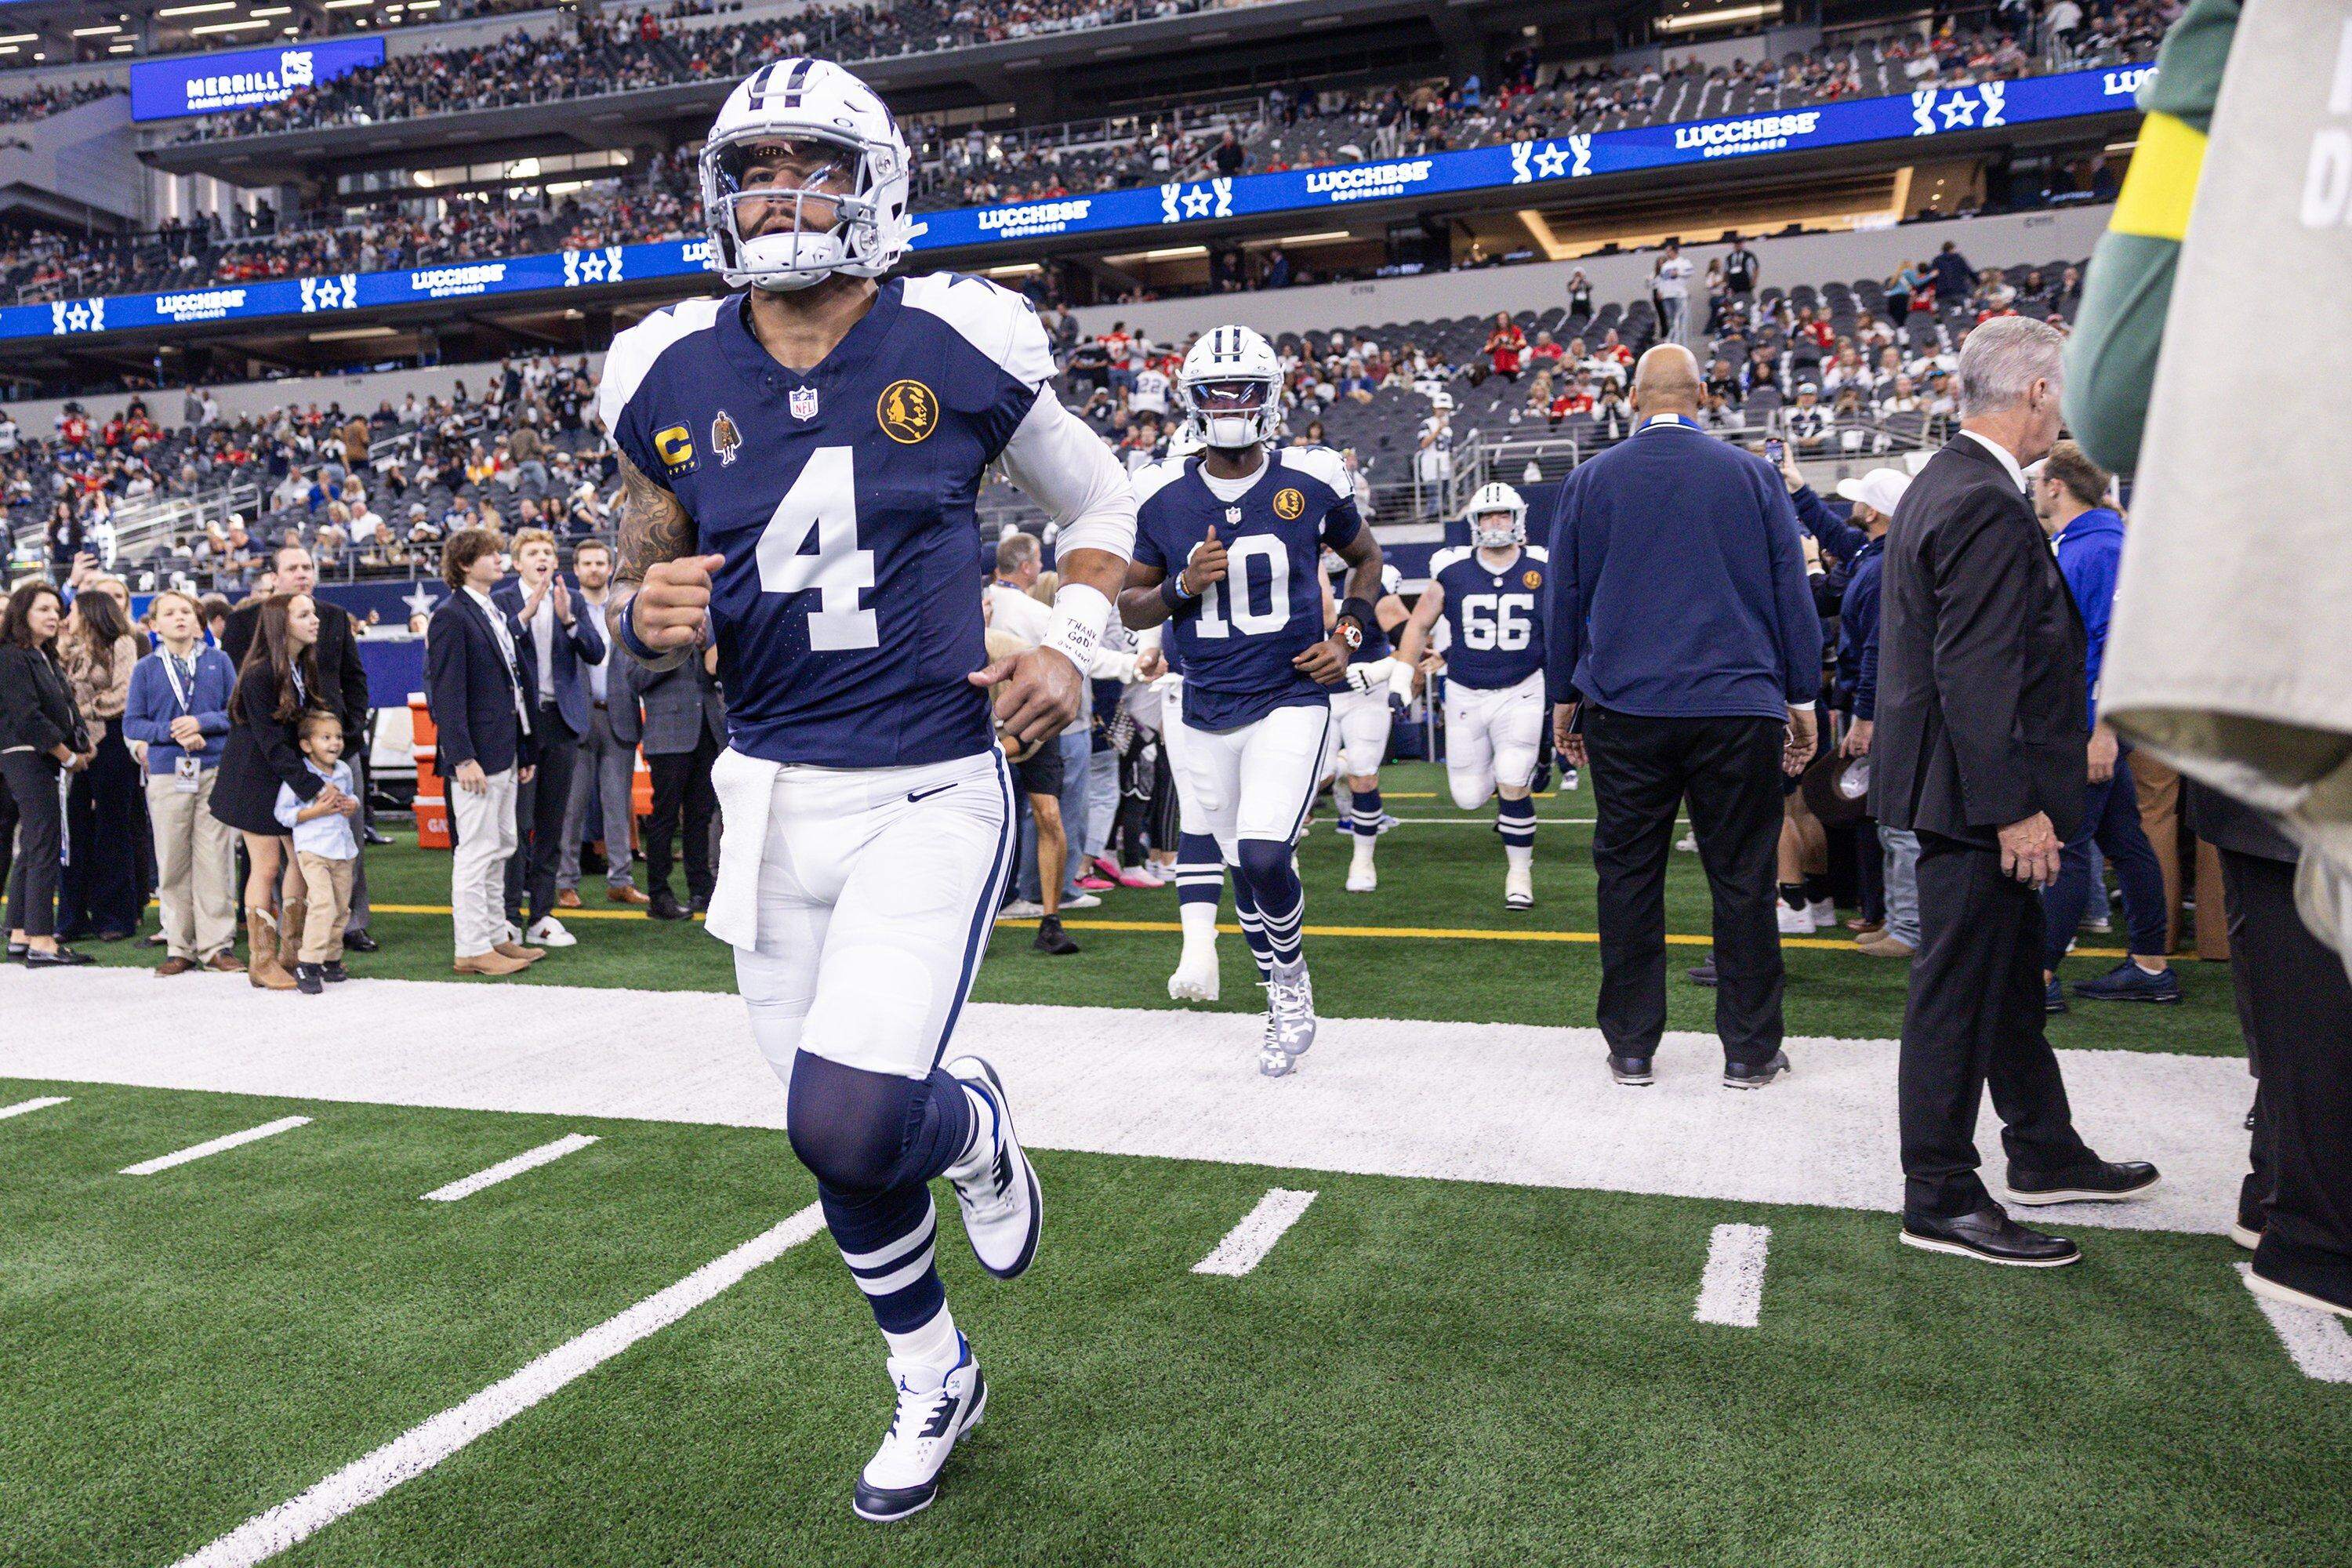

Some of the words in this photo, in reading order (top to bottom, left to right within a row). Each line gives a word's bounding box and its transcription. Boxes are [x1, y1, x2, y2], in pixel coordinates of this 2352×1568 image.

[187, 71, 280, 98] MERRILL
[1675, 111, 1820, 149] LUCCHESE
[1305, 160, 1433, 193] LUCCHESE
[978, 200, 1091, 230] LUCCHESE
[794, 401, 814, 415] NFL
[655, 426, 693, 466] C
[755, 445, 880, 651] 4
[1186, 533, 1290, 638] 10
[1067, 618, 1097, 641] THANK
[1461, 593, 1534, 652] 66
[1068, 631, 1093, 651] GOD!
